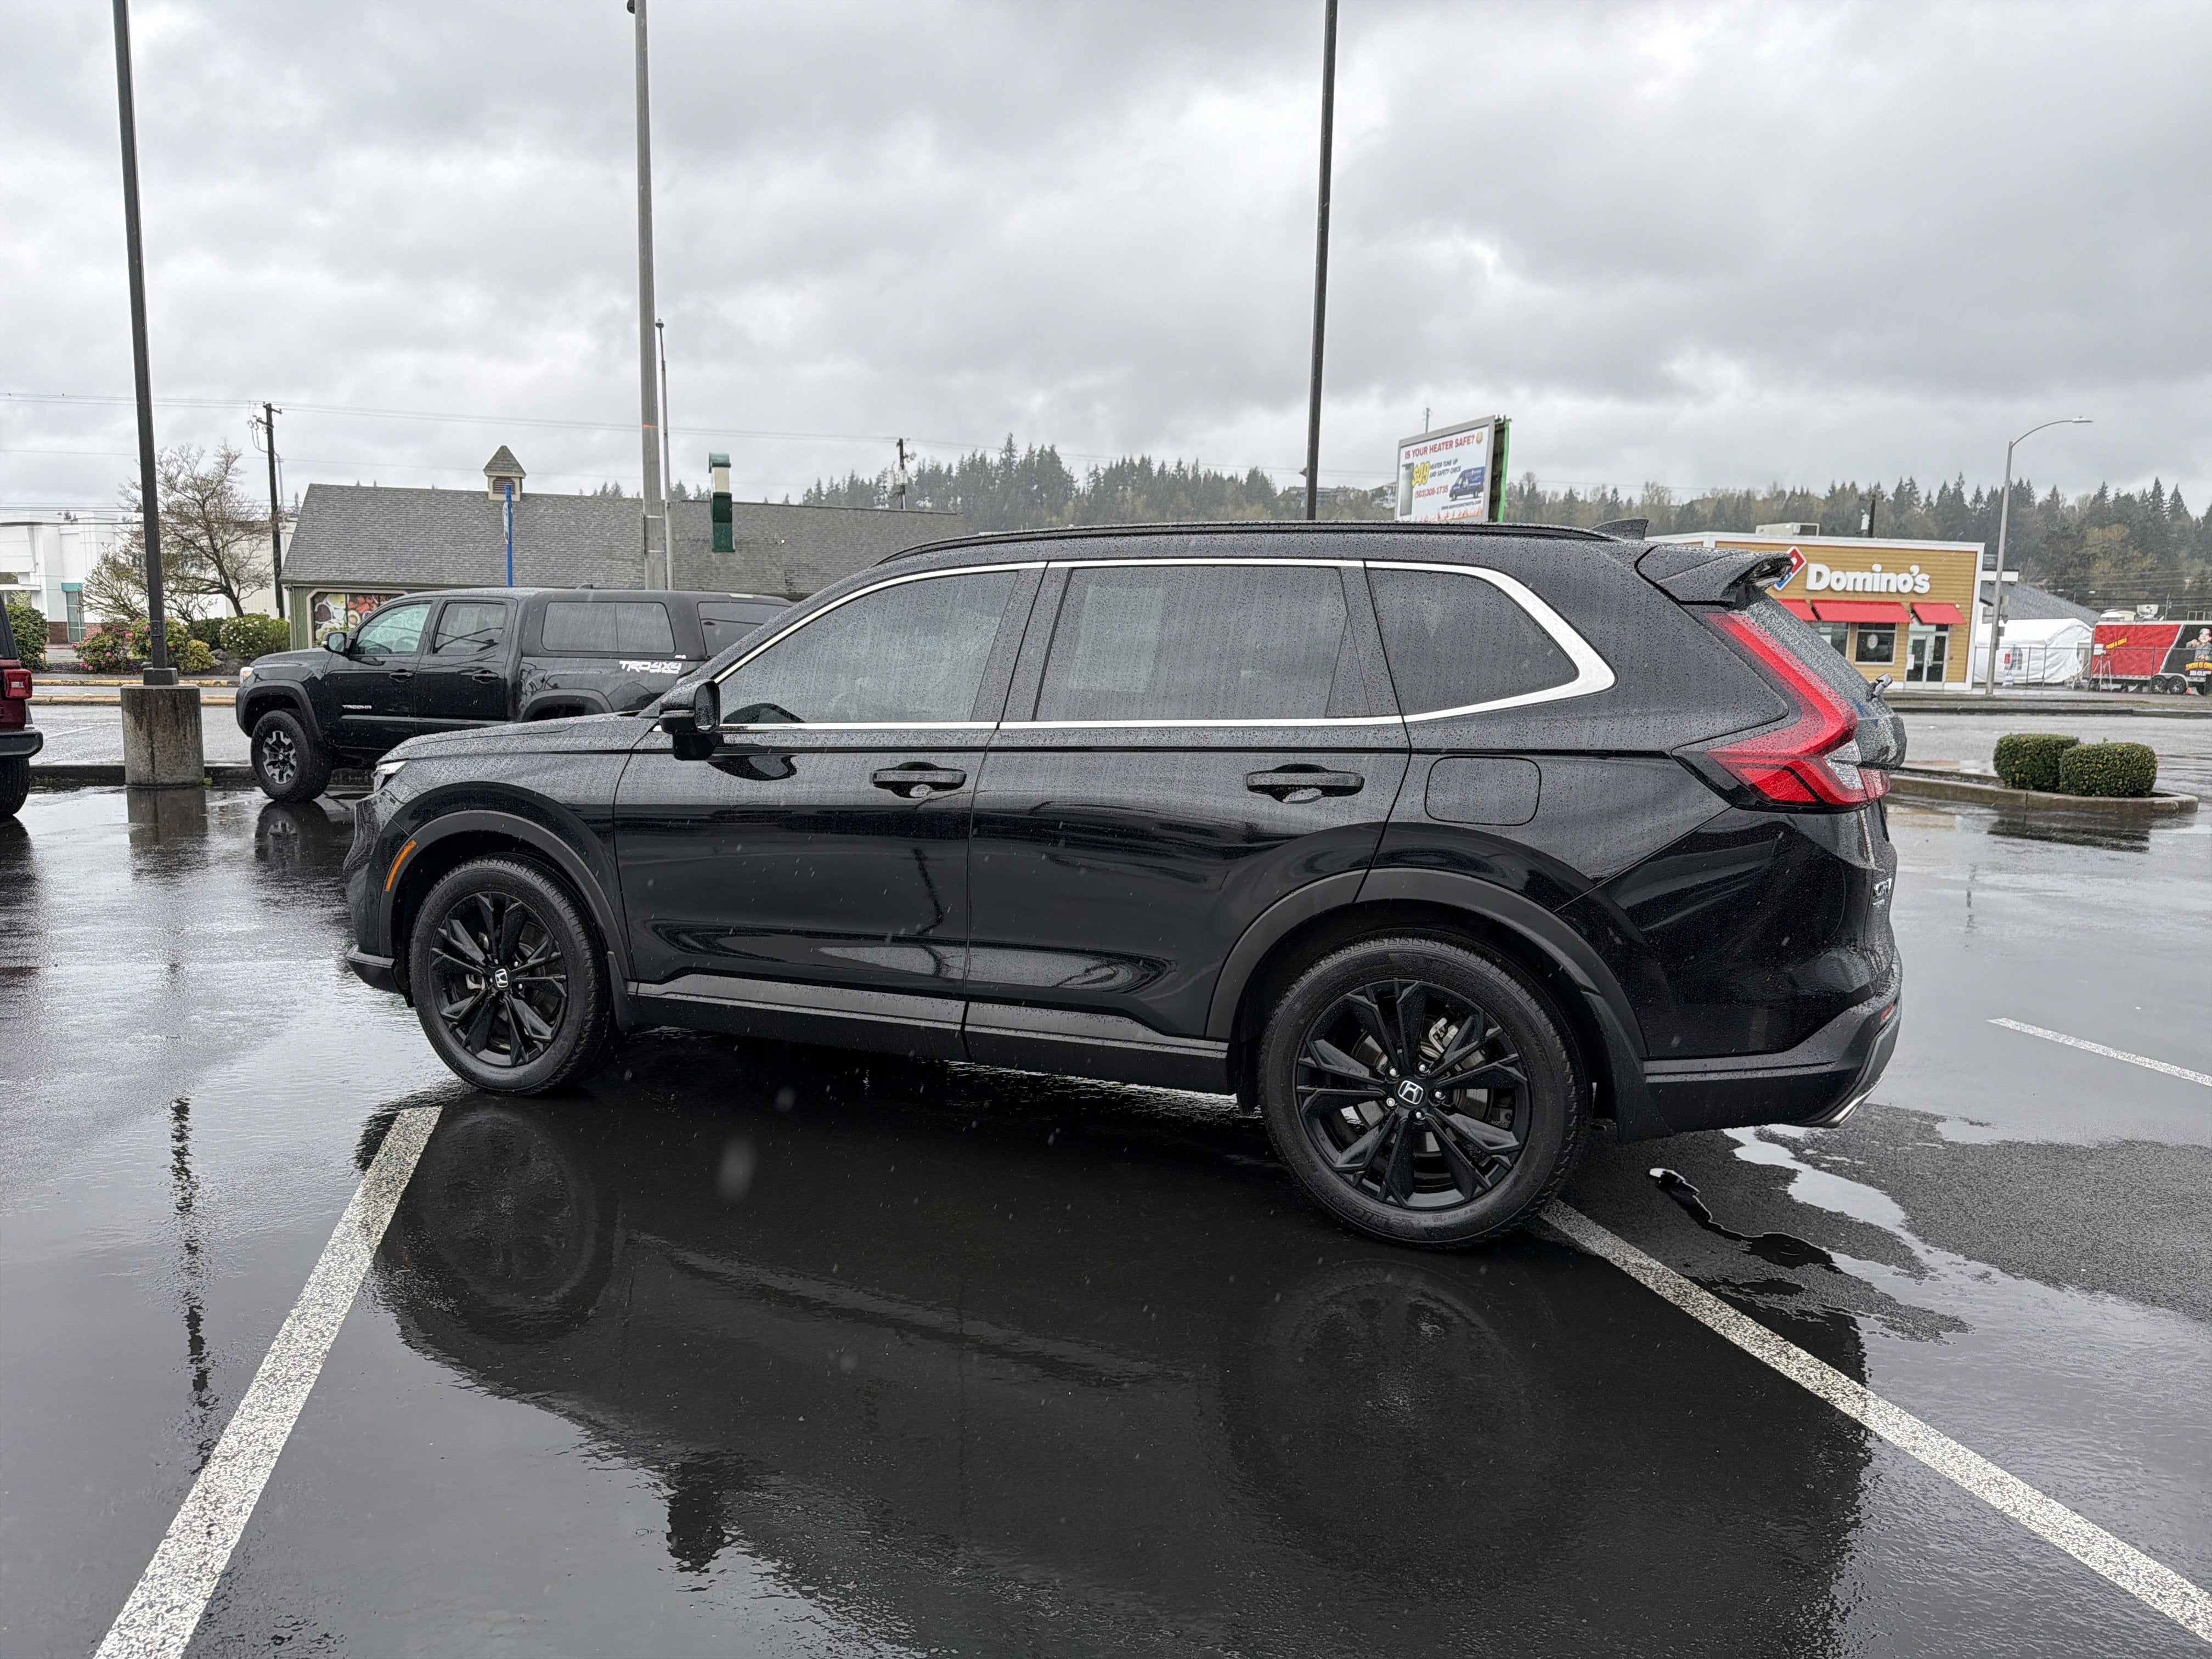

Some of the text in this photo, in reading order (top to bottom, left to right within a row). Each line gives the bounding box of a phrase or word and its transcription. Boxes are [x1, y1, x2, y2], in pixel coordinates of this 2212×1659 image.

[1405, 435, 1475, 459] IS YOUR HEATER SAFE?
[1806, 563, 1931, 594] Domino's
[619, 660, 651, 673] TRD
